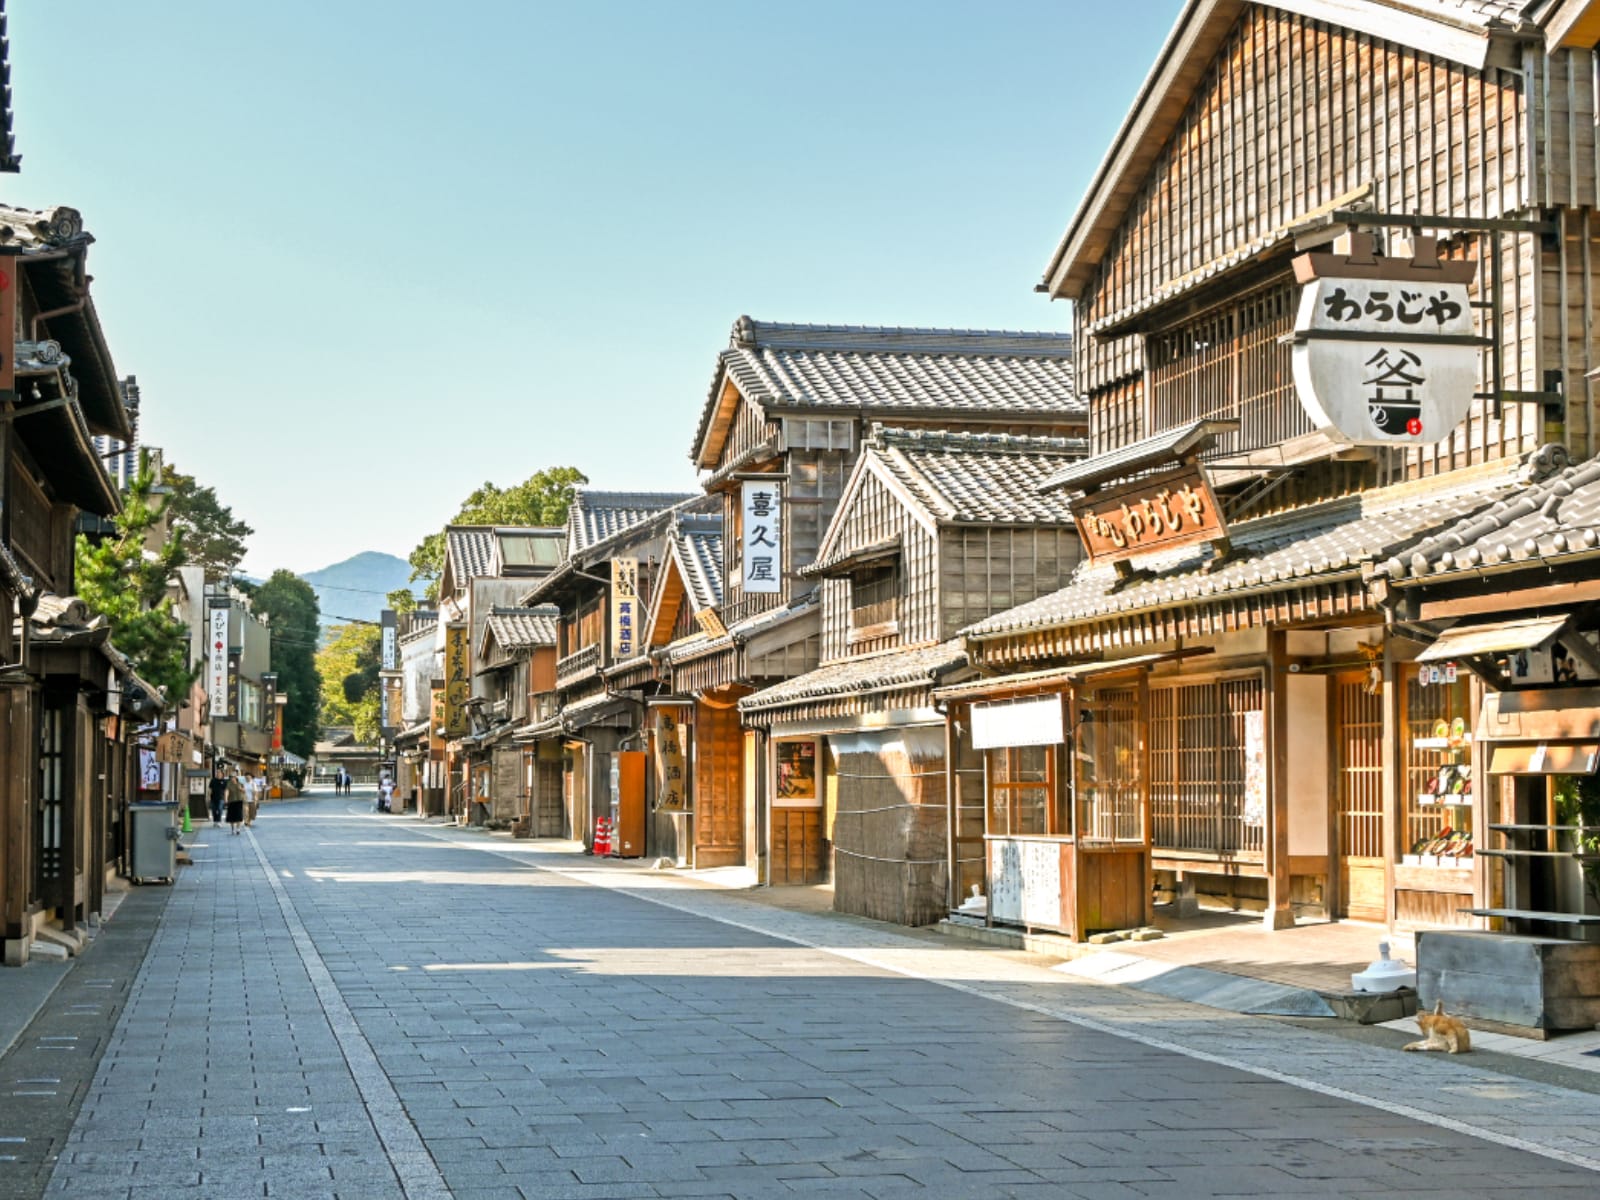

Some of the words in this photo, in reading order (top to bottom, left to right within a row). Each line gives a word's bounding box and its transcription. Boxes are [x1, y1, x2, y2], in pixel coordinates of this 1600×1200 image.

[1323, 287, 1462, 325] わらじや
[746, 491, 776, 582] 喜久屋
[618, 602, 632, 655] 高橋酒店
[660, 714, 681, 806] 高橋酒店
